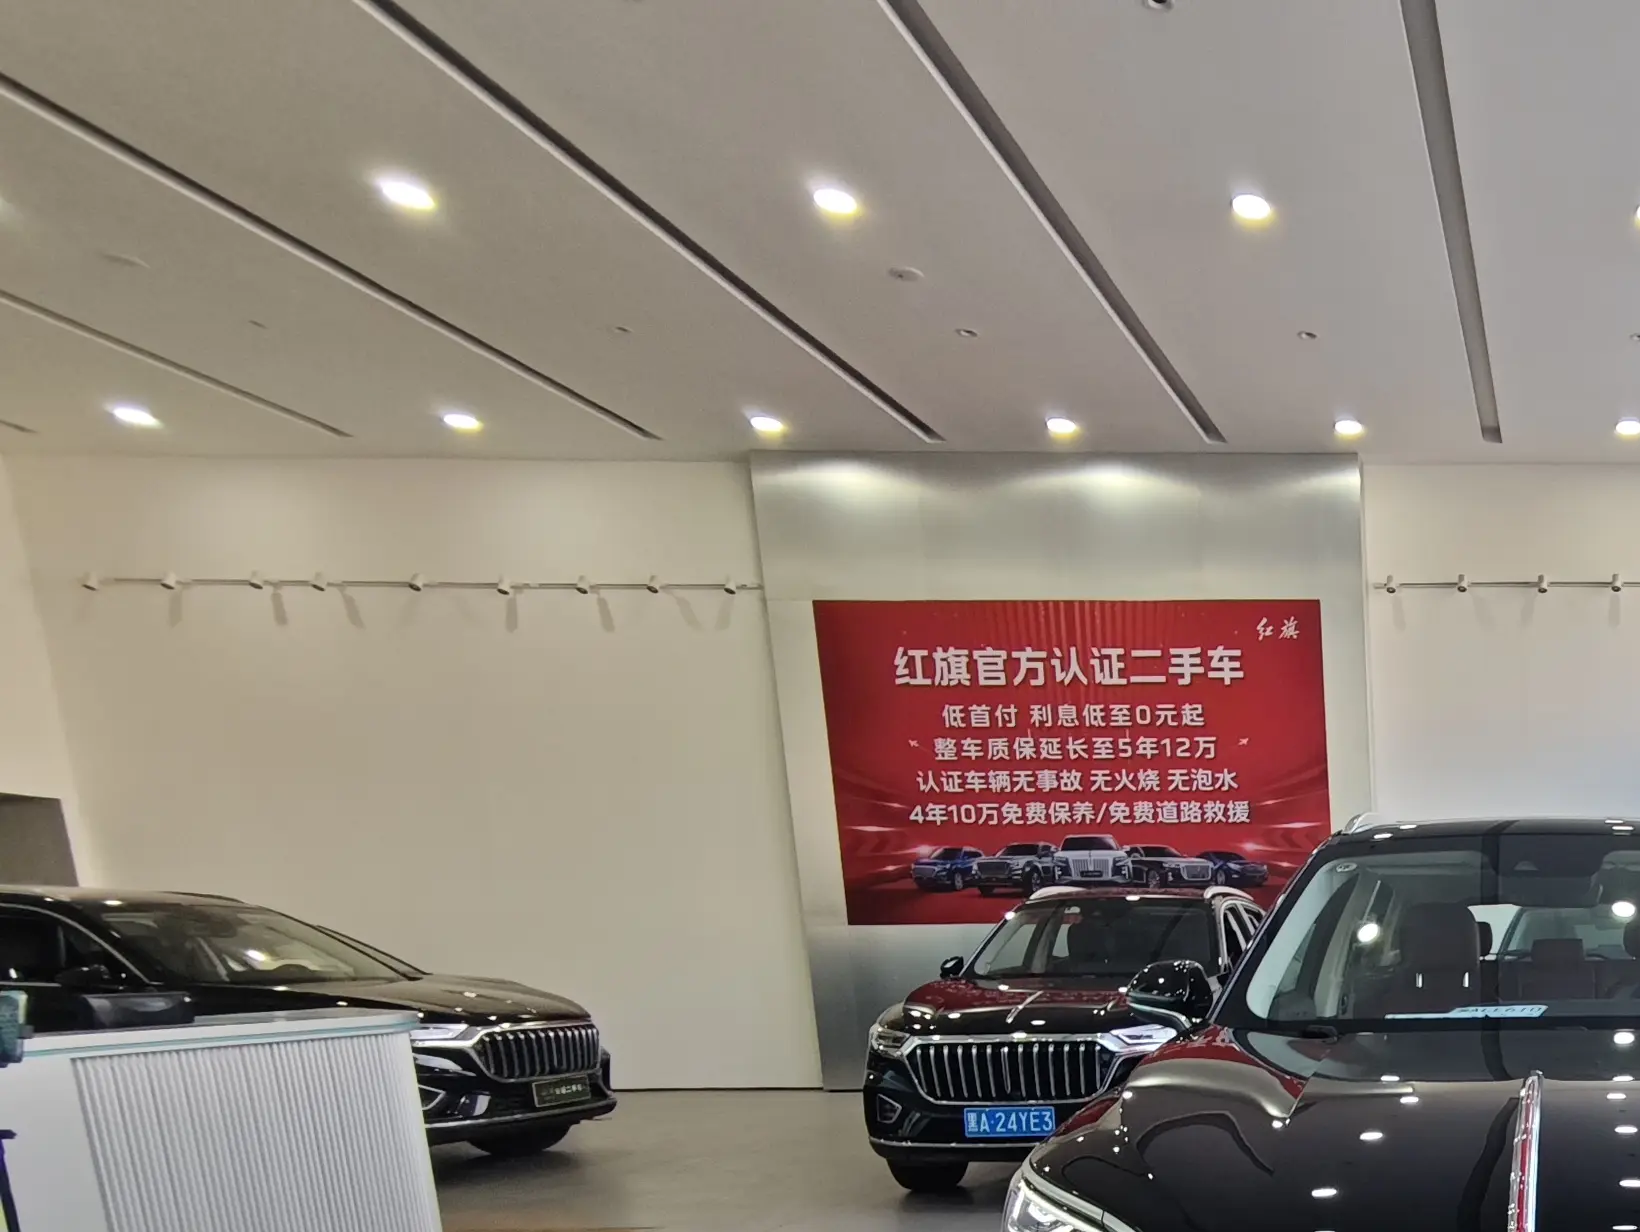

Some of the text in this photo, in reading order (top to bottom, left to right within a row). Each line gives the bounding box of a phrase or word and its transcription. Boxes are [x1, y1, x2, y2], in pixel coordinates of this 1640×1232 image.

[1256, 615, 1300, 641] 红旗
[894, 646, 1244, 687] 红旗官方认证二手车
[942, 703, 1205, 728] 低首付 利息低至0元起
[934, 736, 1217, 761] 整车质保延长至5年12万
[916, 768, 1239, 793] 认证车辆无事故 无火烧 无泡水
[909, 800, 1251, 826] 4年10万免费保养/免费道路救援
